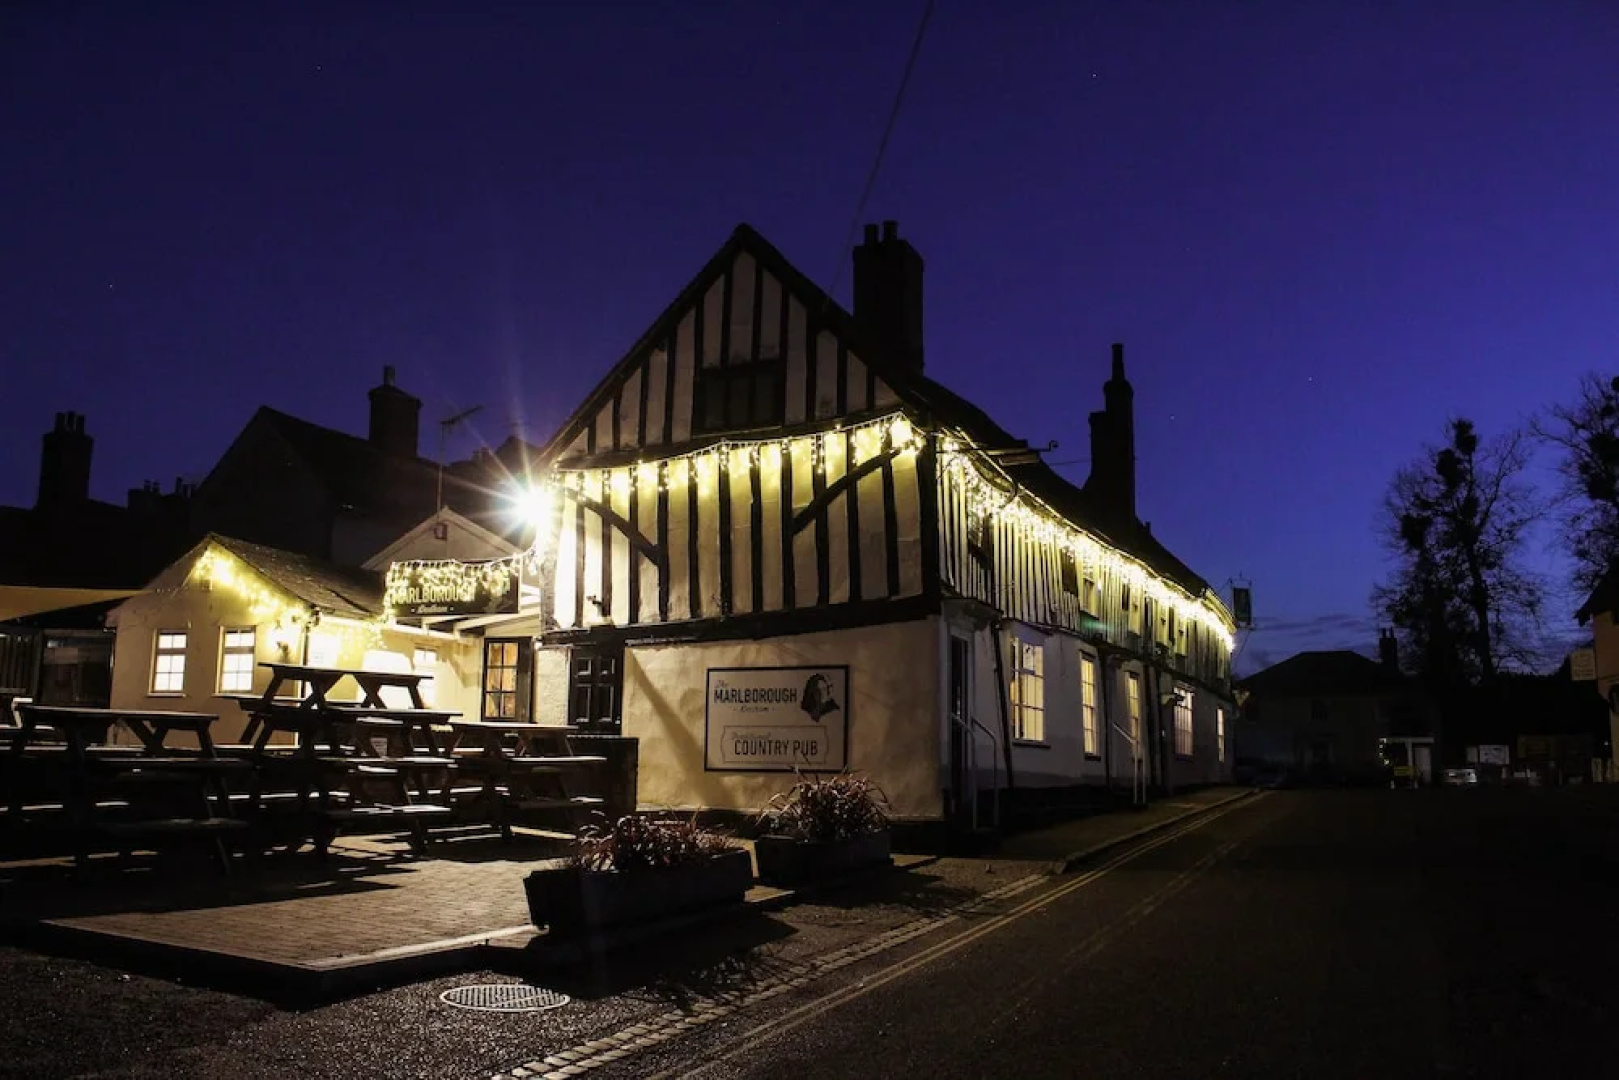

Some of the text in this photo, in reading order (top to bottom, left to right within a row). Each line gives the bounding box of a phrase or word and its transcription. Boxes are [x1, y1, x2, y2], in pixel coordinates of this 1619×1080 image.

[714, 688, 797, 703] MARLBOROUGH
[735, 740, 818, 756] COUNTRY PUB
